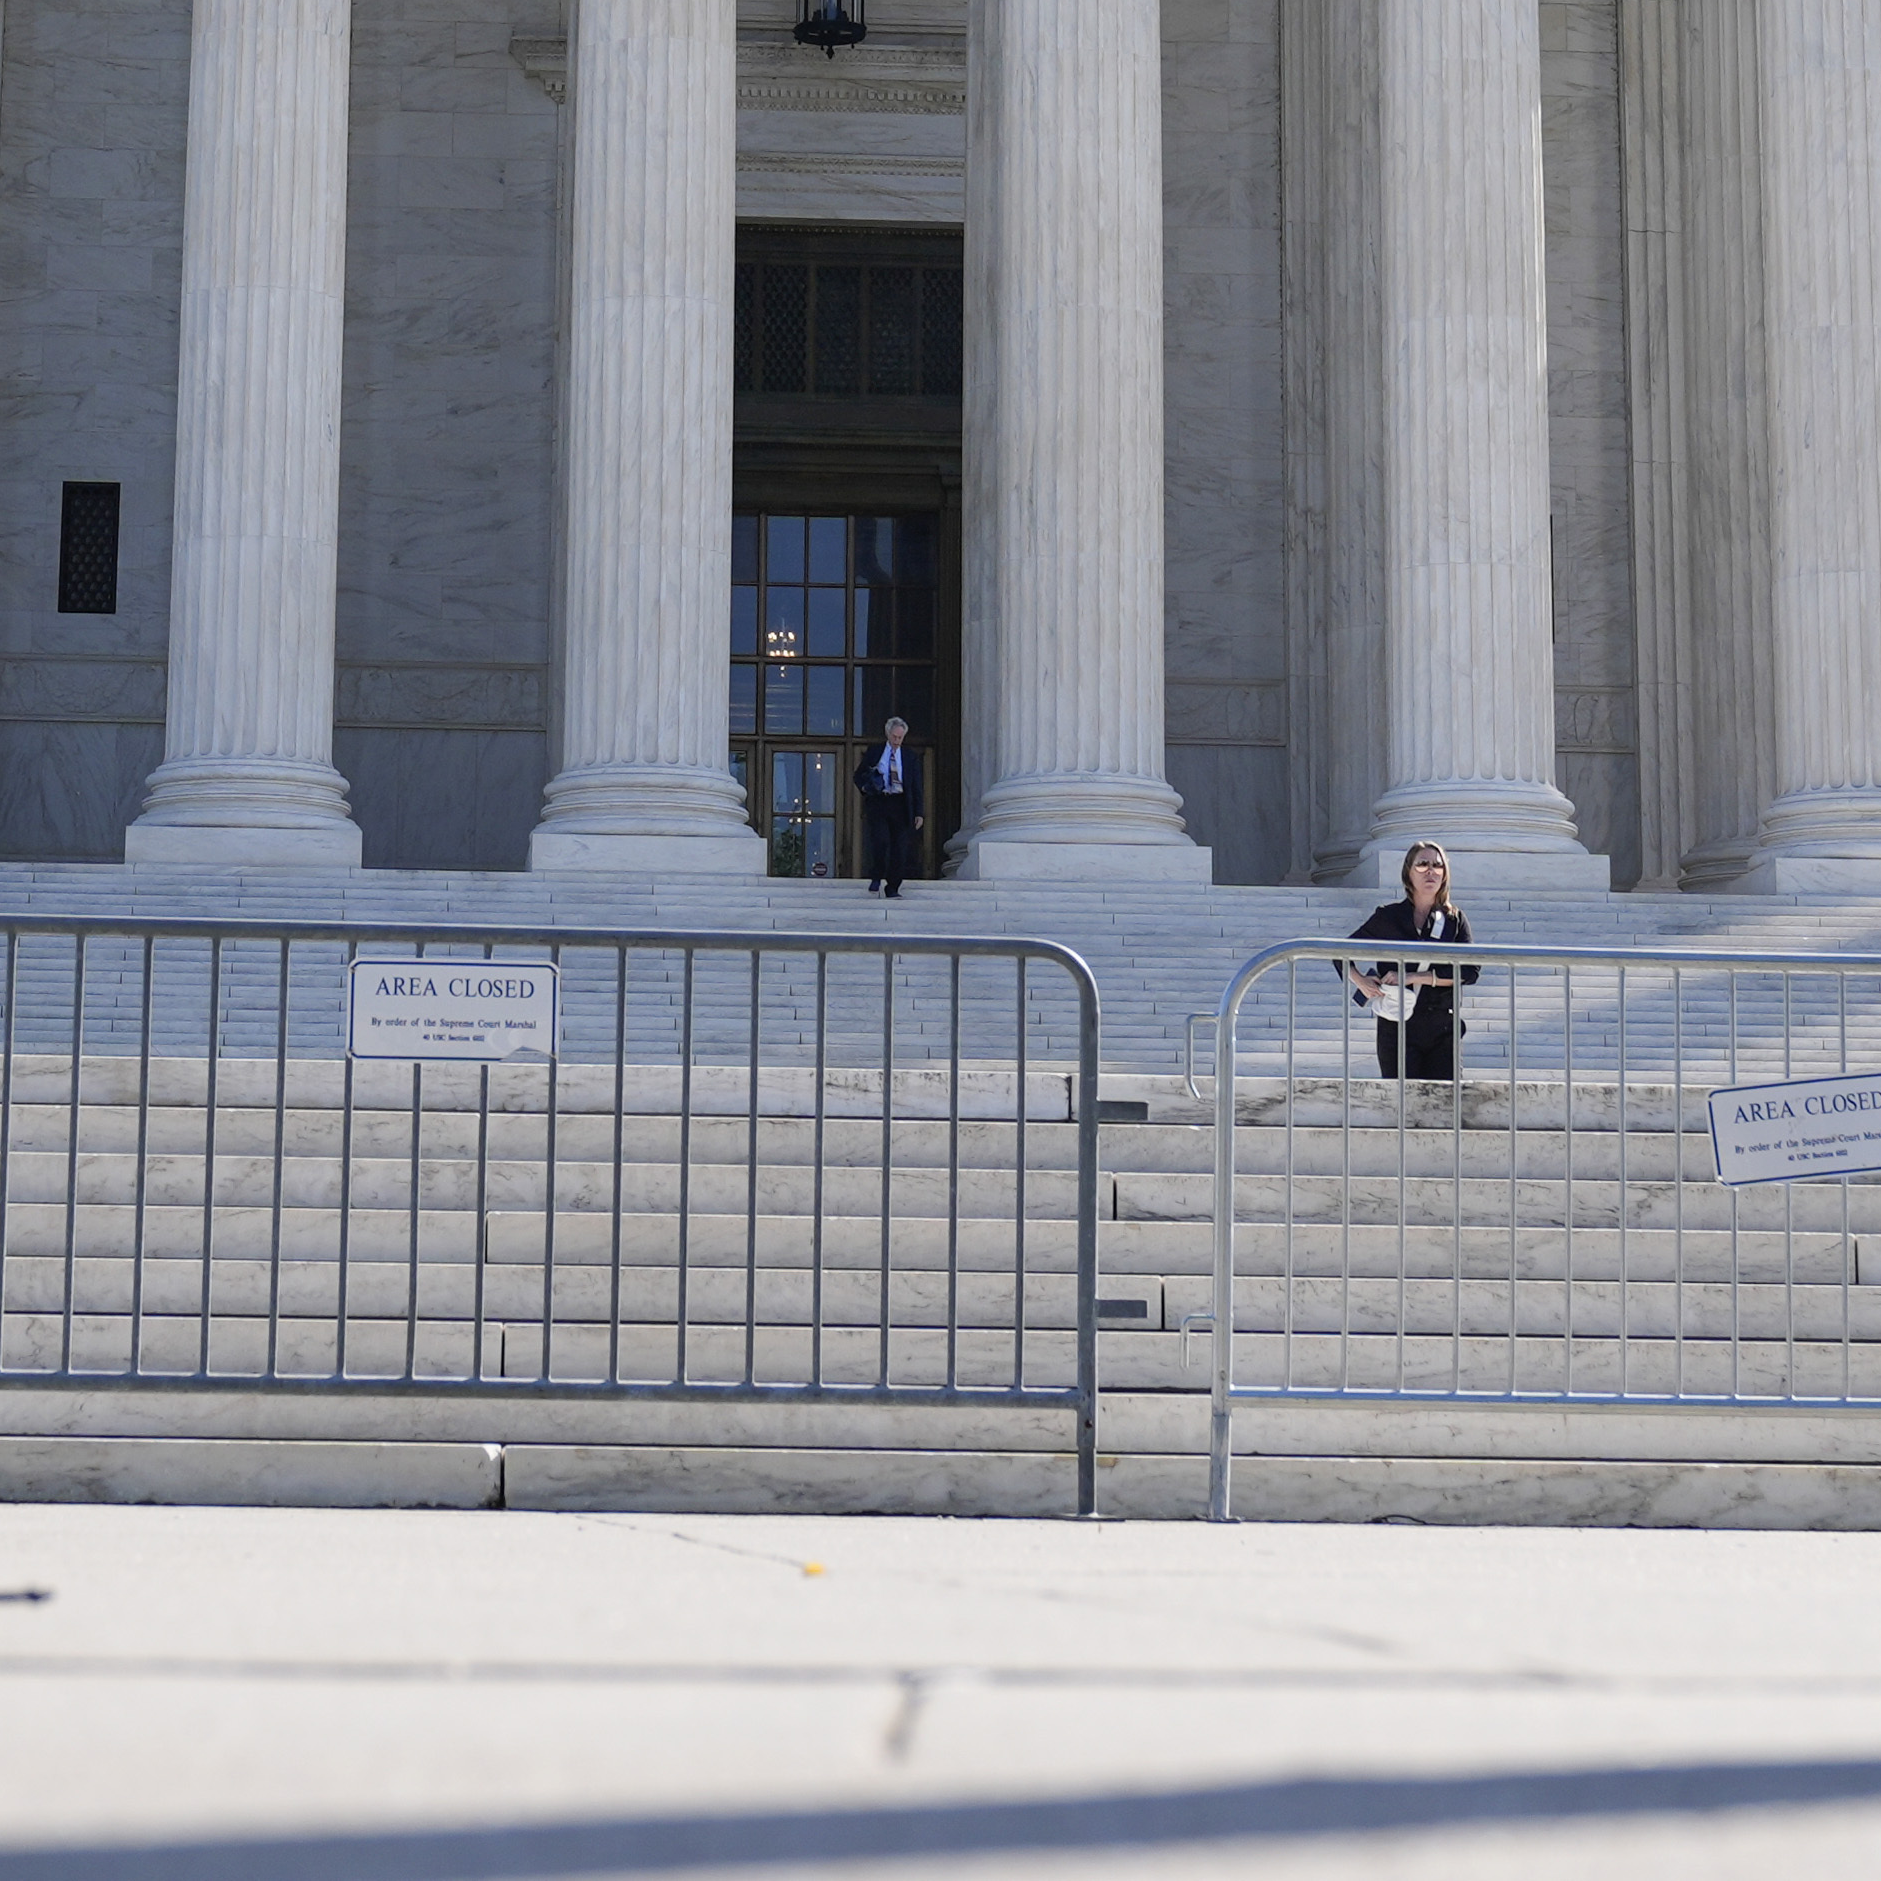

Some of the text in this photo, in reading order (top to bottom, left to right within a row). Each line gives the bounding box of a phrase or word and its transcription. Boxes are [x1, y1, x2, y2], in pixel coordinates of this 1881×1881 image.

[375, 977, 535, 999] AREA CLOSED
[371, 1017, 537, 1030] By order of the Supreme Court Marshal
[1734, 1100, 1796, 1124] AREA
[1734, 1145, 1745, 1155] By
[1748, 1142, 1770, 1152] order
[1773, 1140, 1782, 1149] of
[1786, 1138, 1799, 1148] the
[1802, 1136, 1836, 1148] Supreme
[1838, 1133, 1861, 1143] Court
